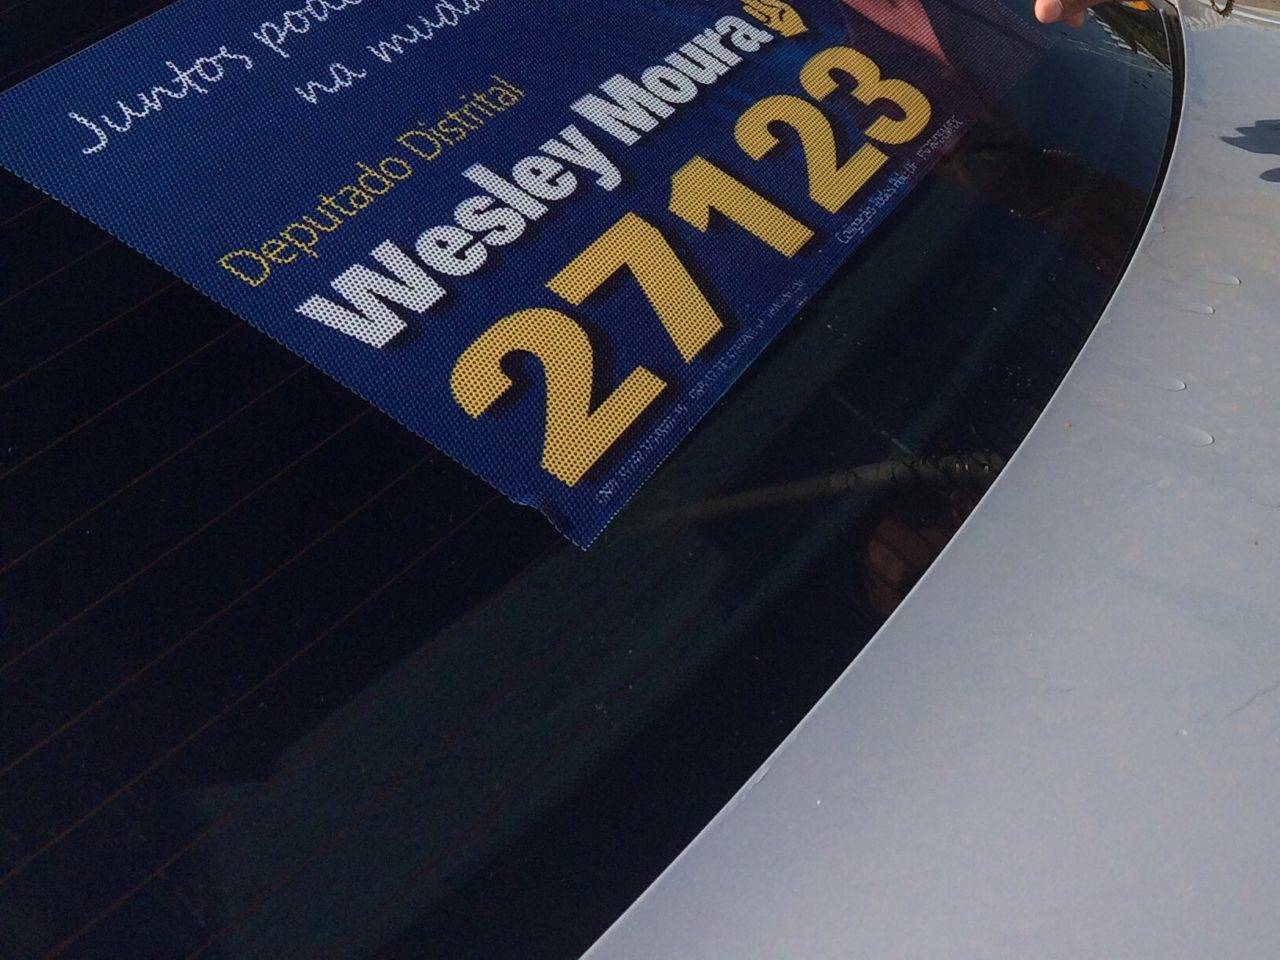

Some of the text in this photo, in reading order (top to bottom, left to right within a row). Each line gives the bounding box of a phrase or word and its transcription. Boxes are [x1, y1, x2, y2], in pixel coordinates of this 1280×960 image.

[69, 46, 253, 155] Juntos
[218, 75, 525, 287] Deputado Distrital
[295, 123, 622, 348] Wesley
[570, 14, 775, 147] Moura
[296, 63, 367, 104] na
[450, 46, 933, 488] 27123
